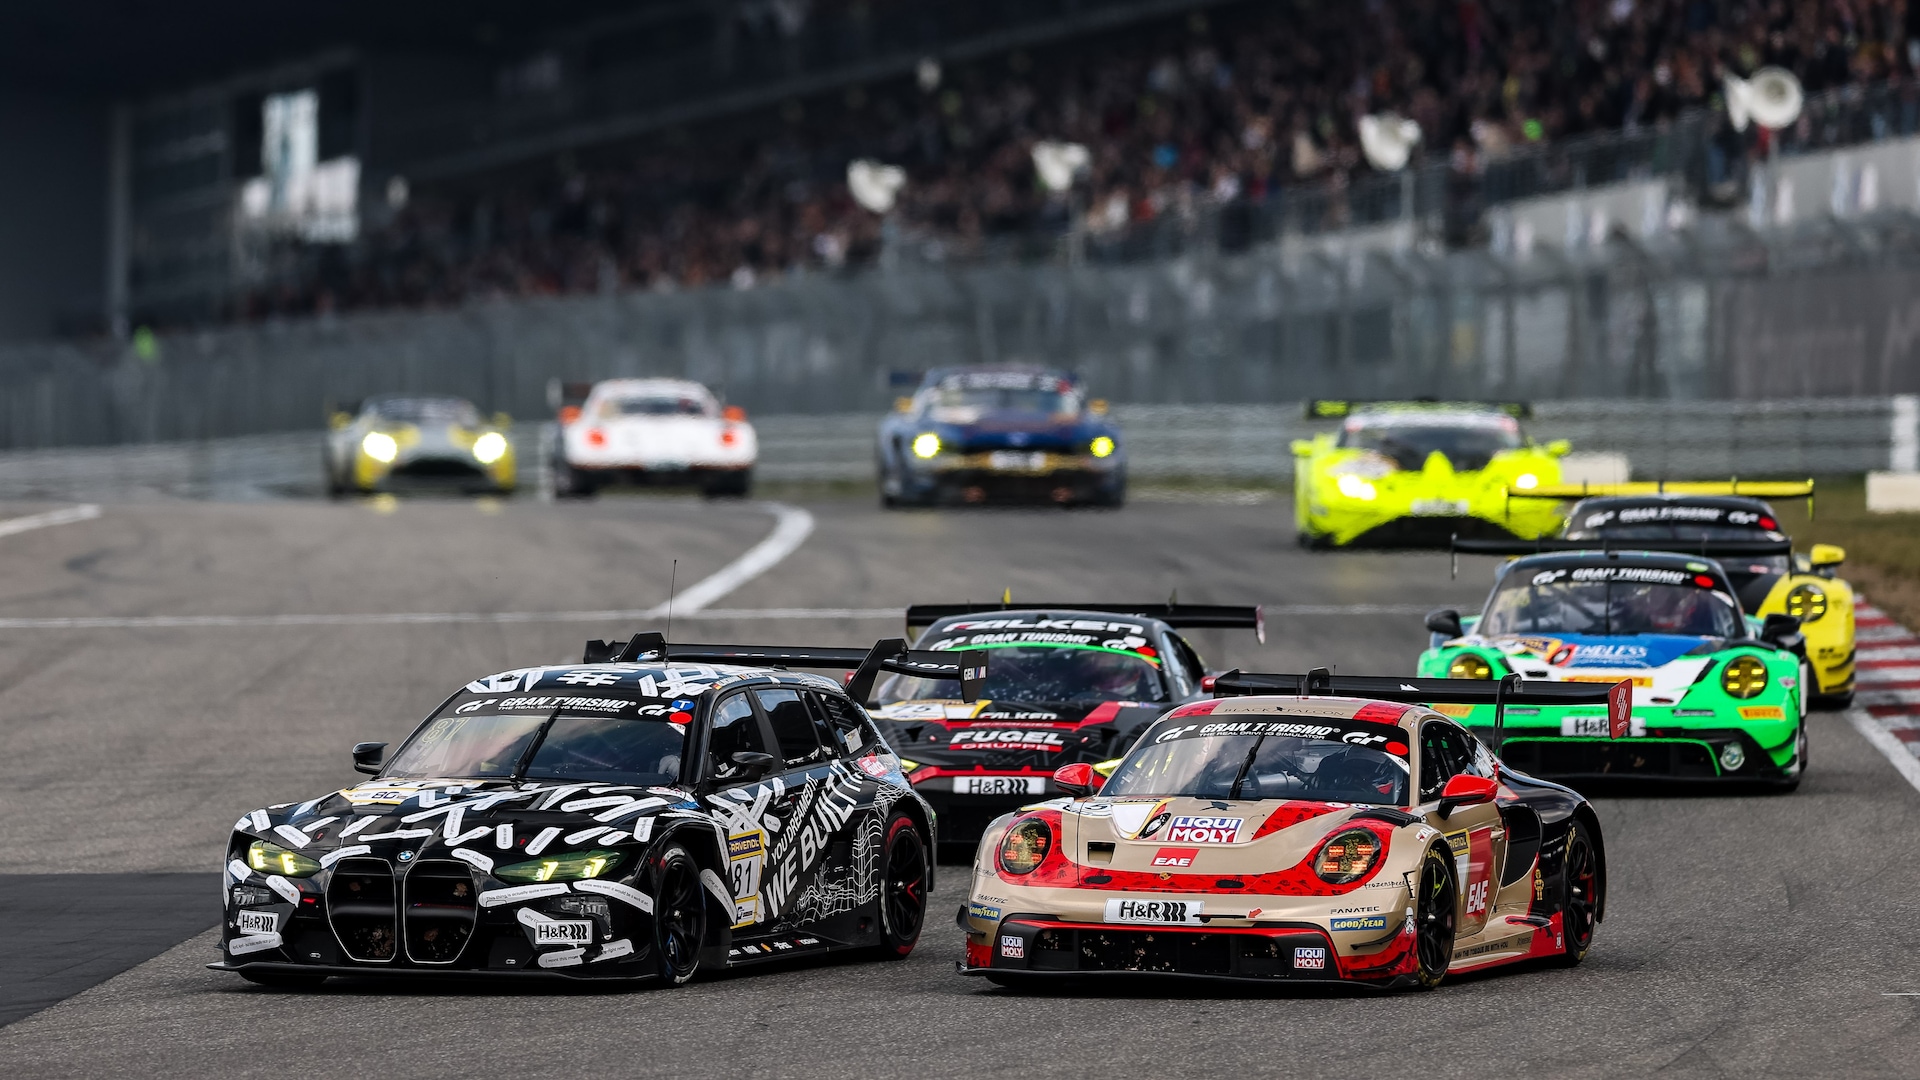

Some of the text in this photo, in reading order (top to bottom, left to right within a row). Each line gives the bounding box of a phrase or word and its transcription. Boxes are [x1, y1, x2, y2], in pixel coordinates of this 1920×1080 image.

[942, 619, 1144, 635] FALKEN
[970, 633, 1015, 645] GRAN
[499, 696, 552, 707] GRAN
[679, 700, 691, 709] T
[571, 705, 620, 713] SIMULATOR
[1287, 708, 1344, 716] FALCON
[979, 711, 1058, 720] FALKEN
[422, 716, 472, 743] 81
[1200, 723, 1253, 734] GRAN
[950, 730, 1065, 745] FUGEL
[1275, 732, 1325, 740] SIMULATOR
[961, 743, 1050, 751] GRUPPE
[772, 833, 788, 866] YOU
[786, 782, 814, 843] DREAMED
[1175, 817, 1238, 829] LIQUI
[1170, 829, 1236, 844] MOLY
[730, 838, 760, 853] RAVENOL
[766, 847, 798, 919] WE
[800, 772, 858, 872] BUILT
[1153, 857, 1192, 867] EAE
[734, 861, 752, 897] 81
[1466, 880, 1489, 914] EAE
[1330, 905, 1380, 914] FANATEC
[1333, 917, 1384, 930] GOODYEAR
[1002, 937, 1022, 948] LIQUI
[1002, 947, 1022, 957] MOLY
[1296, 949, 1323, 959] LIQUI
[1296, 958, 1324, 968] MOLY
